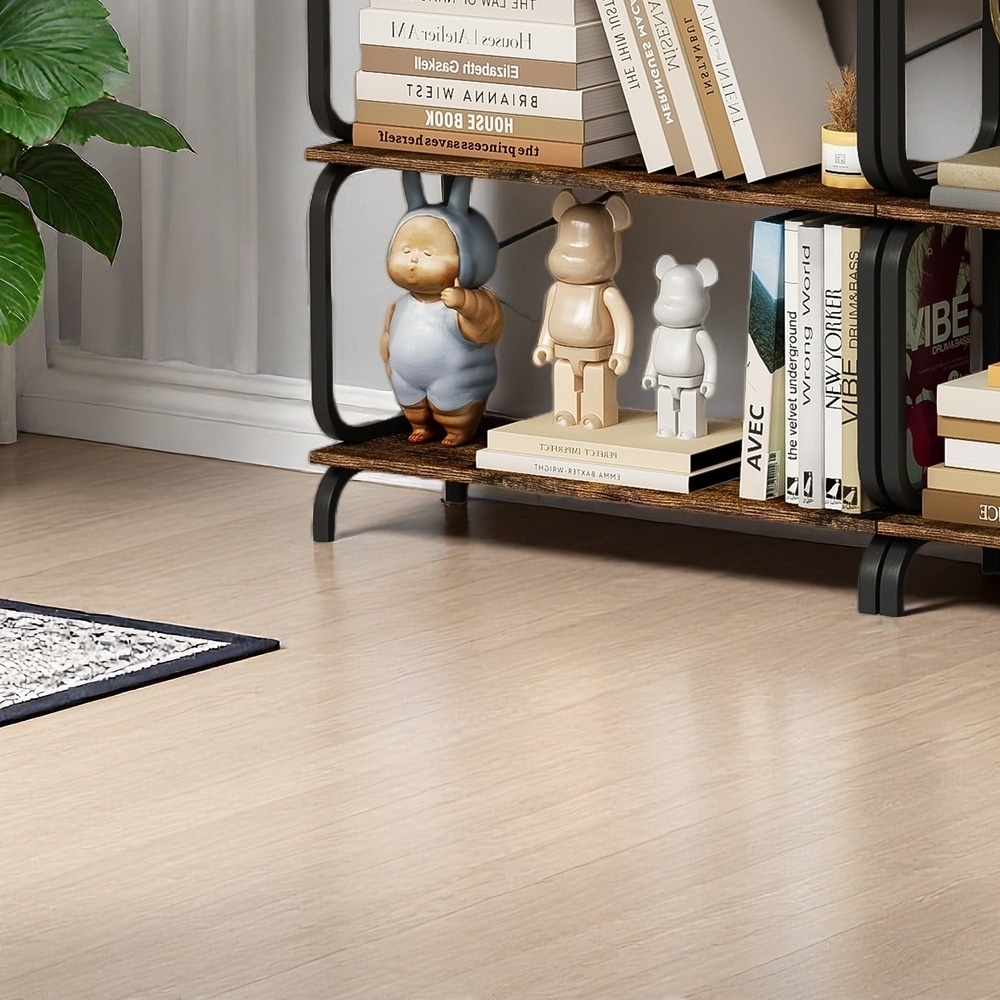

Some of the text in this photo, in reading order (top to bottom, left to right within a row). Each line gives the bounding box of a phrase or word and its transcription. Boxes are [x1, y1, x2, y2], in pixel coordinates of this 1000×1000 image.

[787, 311, 799, 460] the velvet underground
[802, 246, 812, 406] Wrong World
[824, 289, 844, 410] NEW YORKER
[747, 404, 764, 472] AVEC
